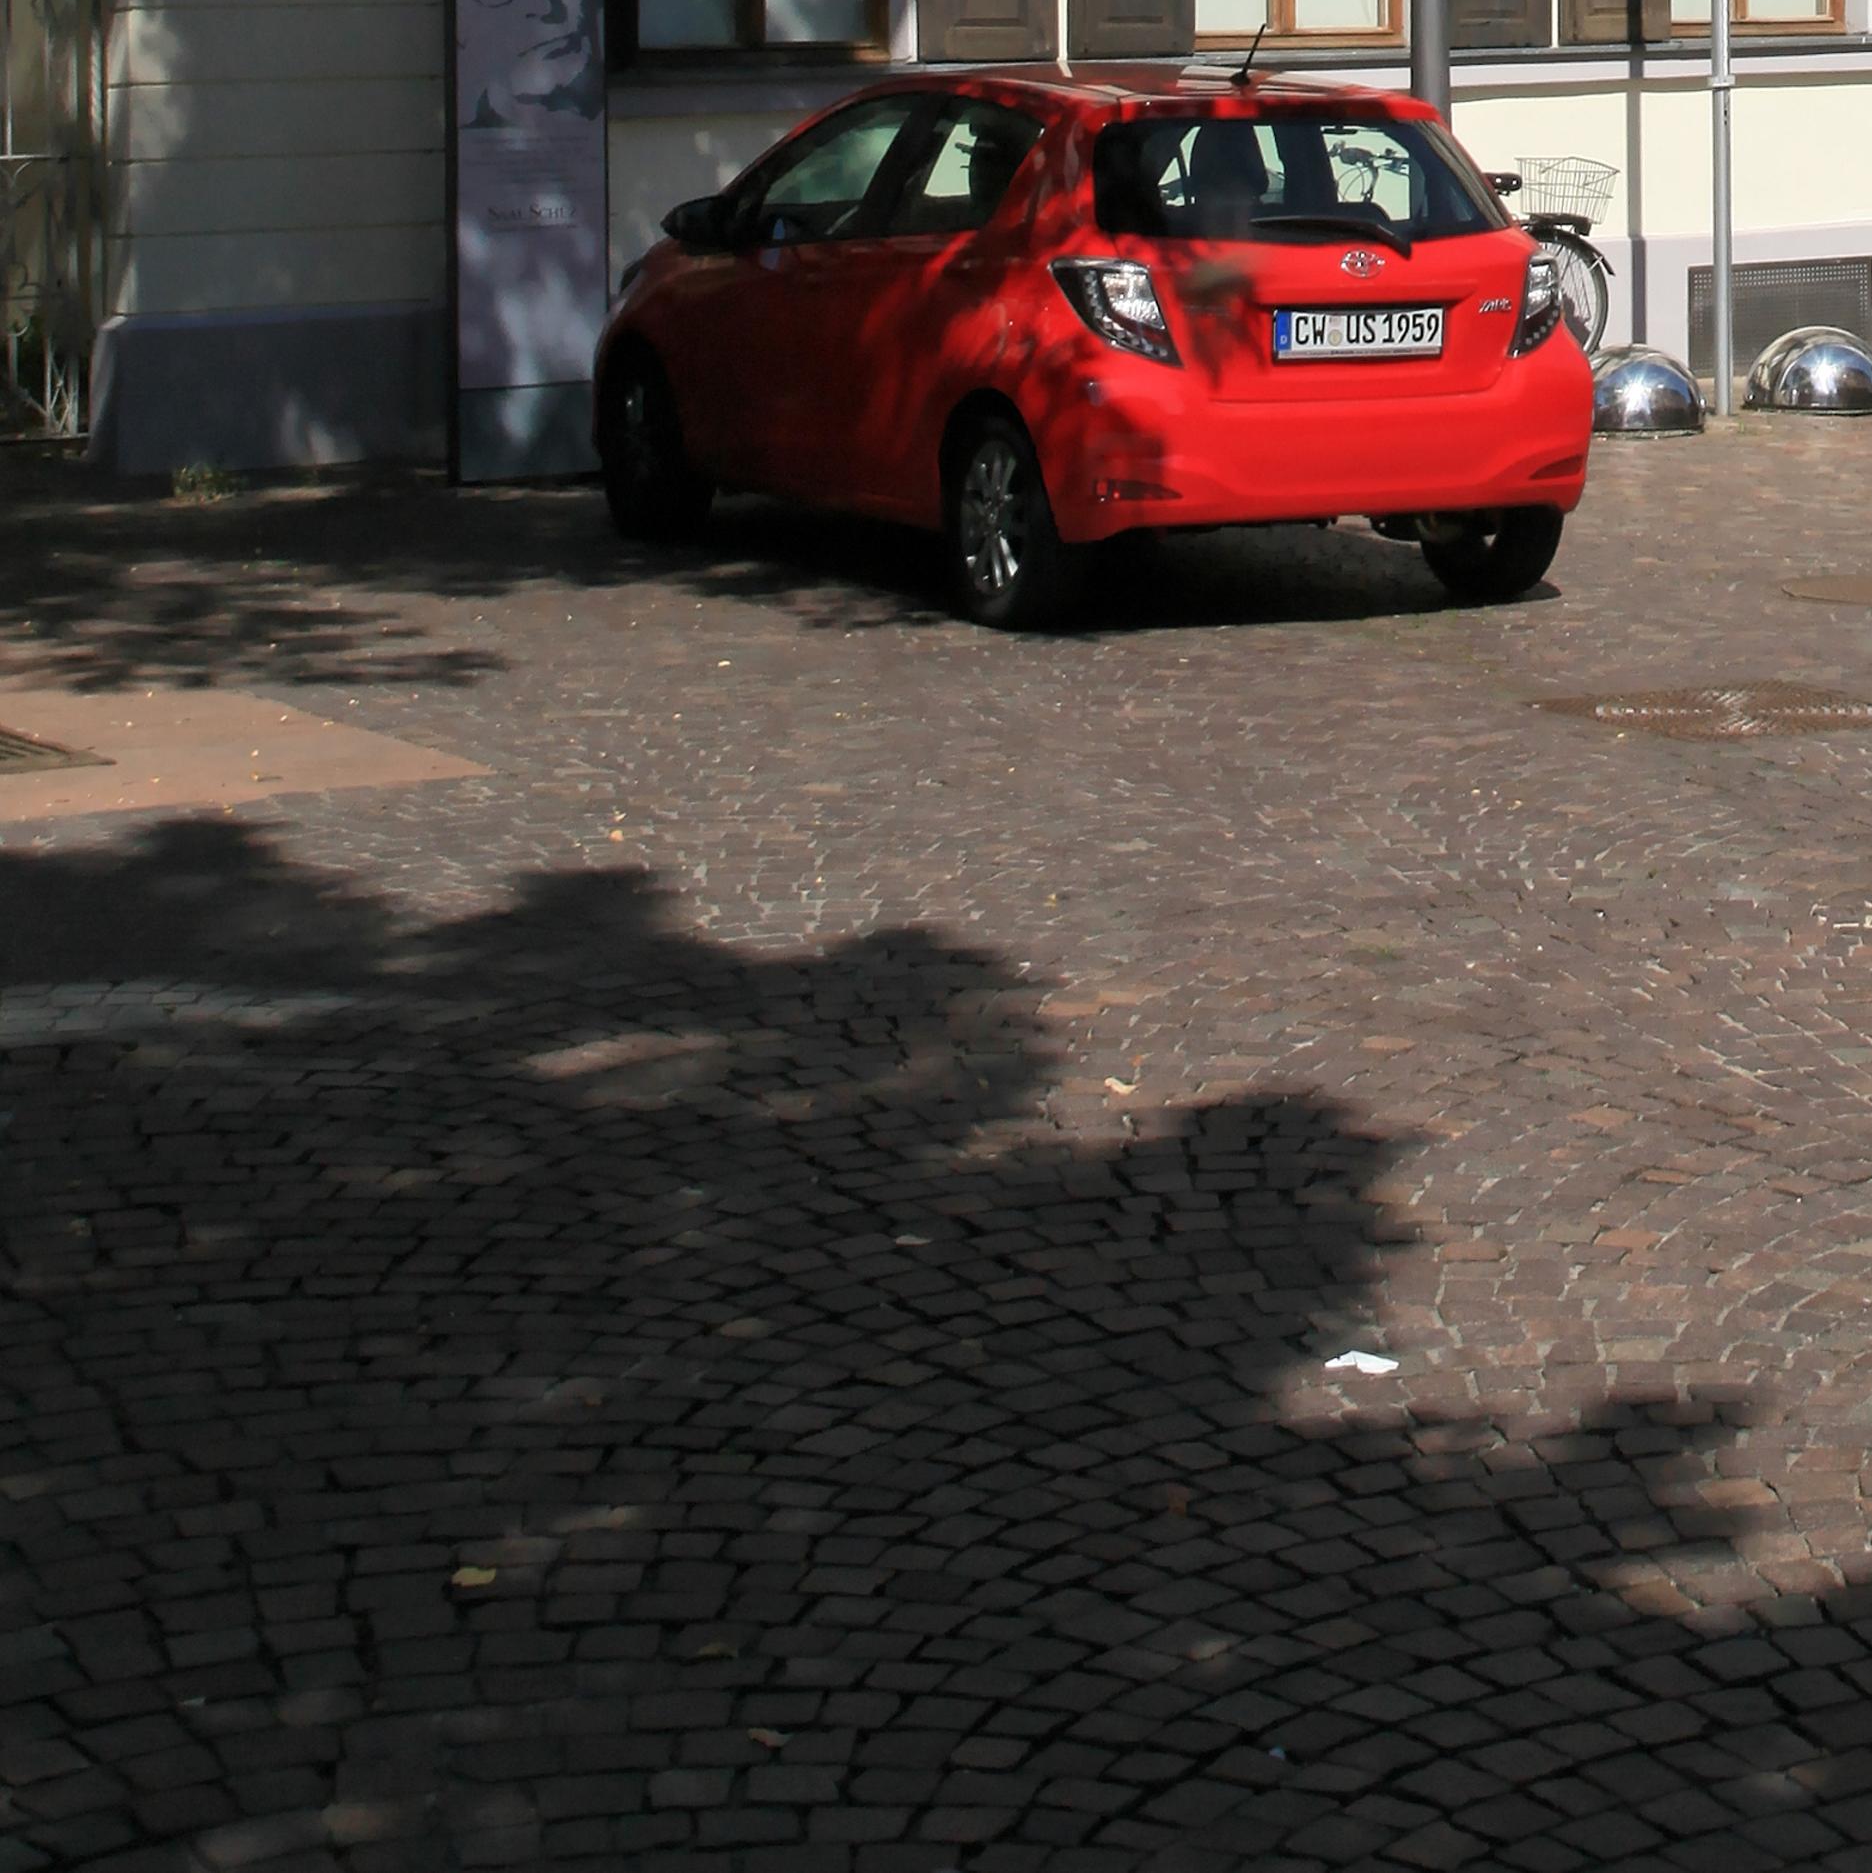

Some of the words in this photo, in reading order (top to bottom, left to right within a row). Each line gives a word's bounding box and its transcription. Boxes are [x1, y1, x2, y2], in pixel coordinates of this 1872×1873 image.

[1295, 315, 1326, 345] CW
[1346, 314, 1376, 344] US
[1382, 313, 1440, 344] 1959
